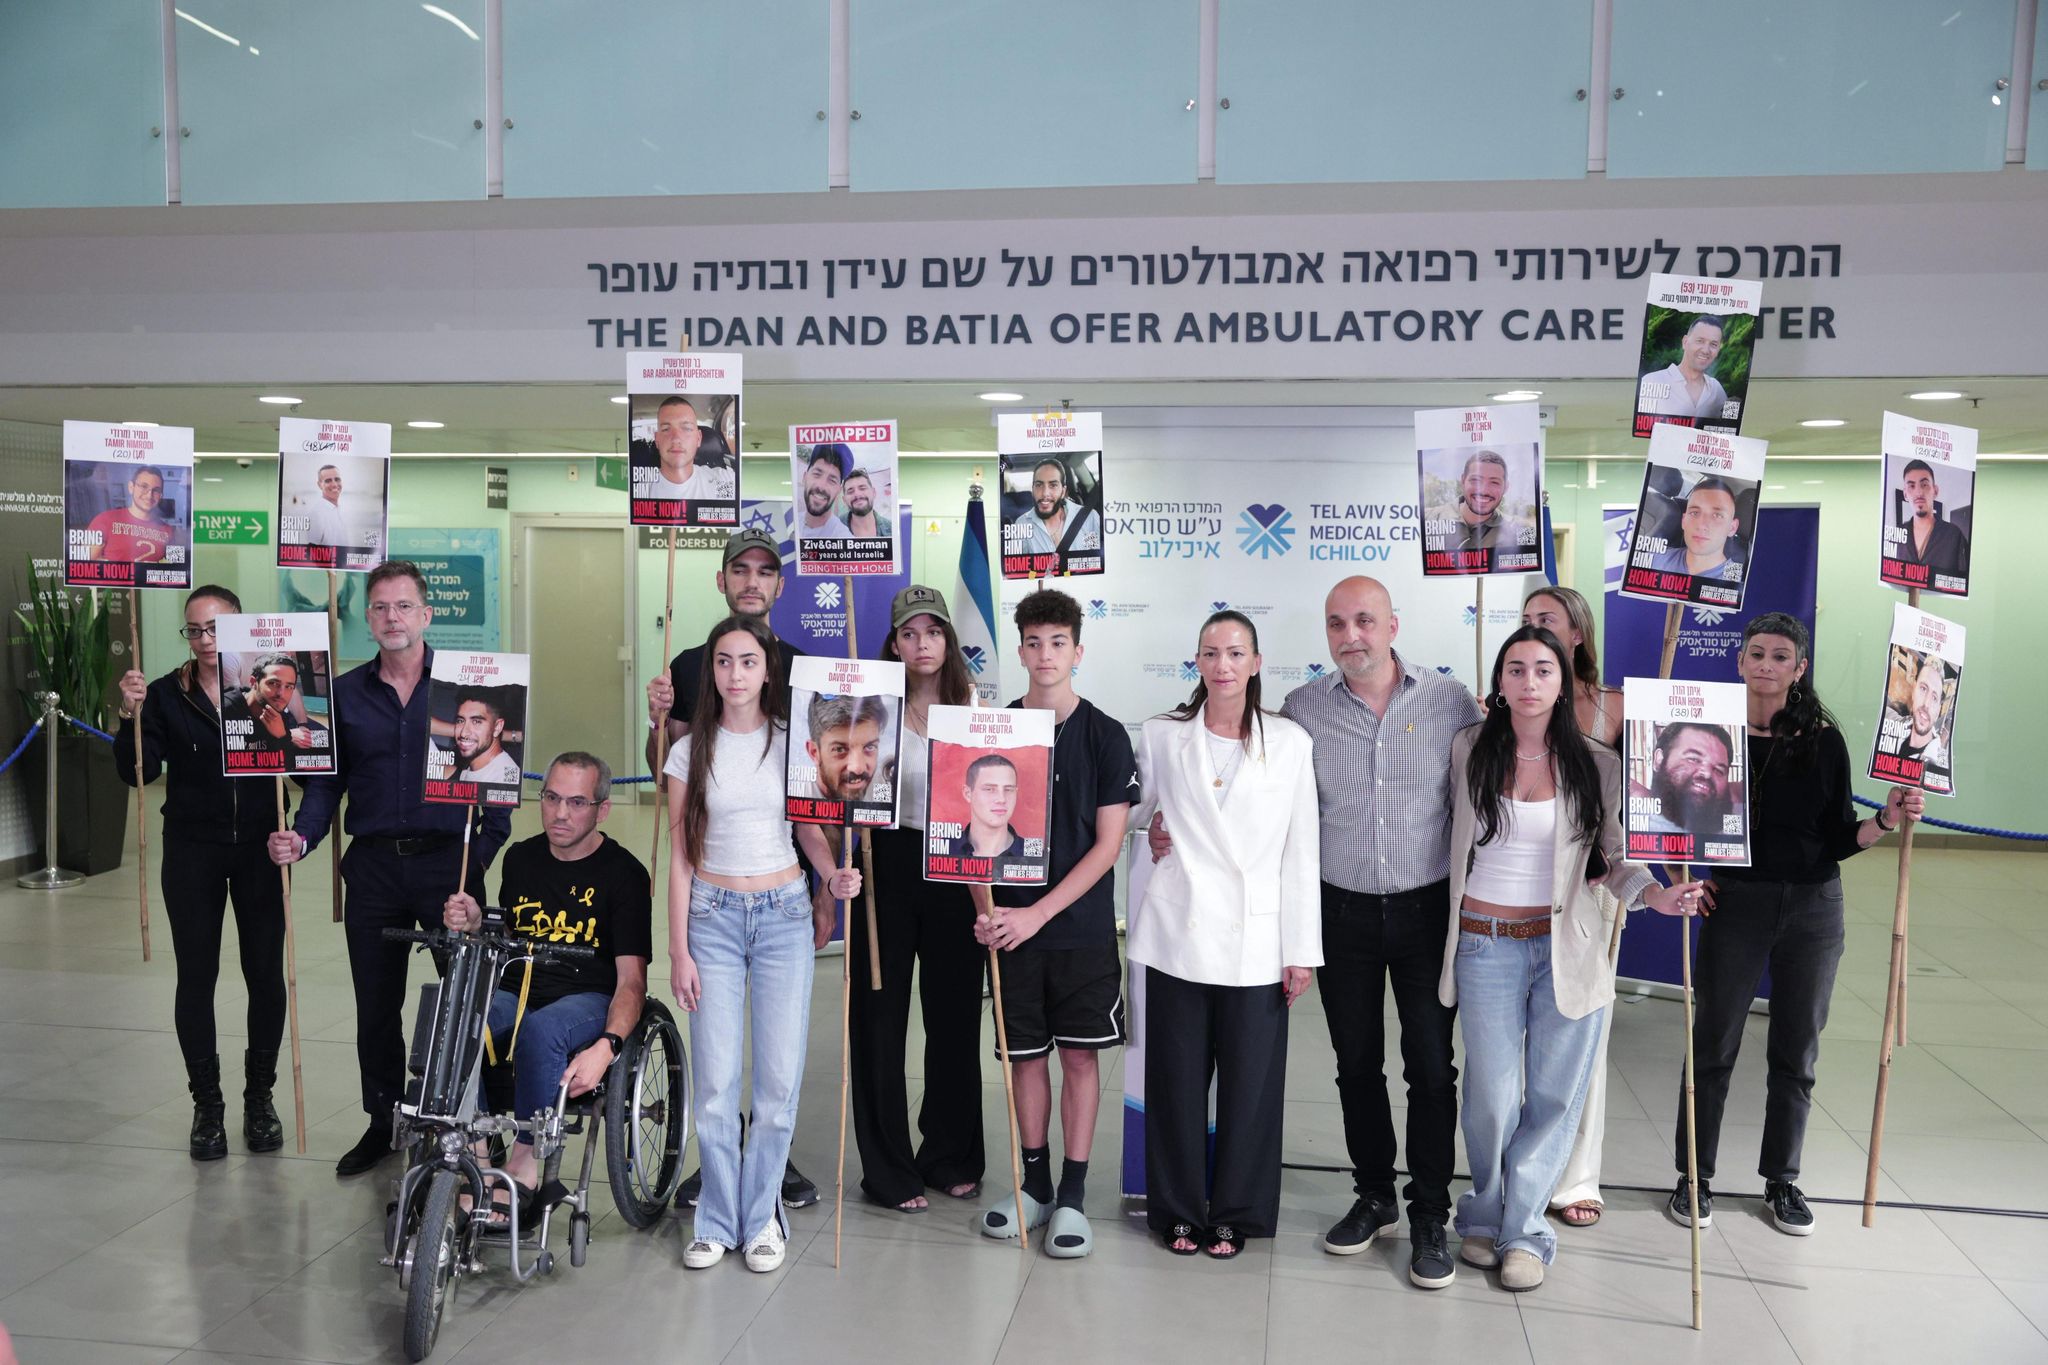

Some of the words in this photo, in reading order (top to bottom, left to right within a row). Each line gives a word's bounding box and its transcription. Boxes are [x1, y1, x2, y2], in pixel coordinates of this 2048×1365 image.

[1001, 248, 1054, 287] על
[1070, 246, 1325, 286] אמבולטורים
[1342, 250, 1478, 283] רפואה
[1494, 239, 1681, 281] לשירותי
[1696, 244, 1842, 279] המרכז
[587, 262, 678, 293] עופר
[693, 260, 808, 291] ובתיה
[822, 258, 907, 298] עידן
[922, 257, 986, 288] שם
[1680, 281, 1696, 294] (53)
[587, 318, 667, 347] THE
[684, 317, 783, 346] IDAN
[797, 316, 887, 346] AND
[907, 314, 1033, 344] BATIA
[1050, 313, 1162, 343] OFER
[1175, 310, 1484, 342] AMBULATORY
[1501, 309, 1624, 341] CARE
[643, 369, 655, 378] BAR
[655, 369, 682, 378] ABRAHAM
[683, 369, 725, 379] KUPERSHTEIN
[674, 379, 688, 389] (22)
[1640, 382, 1671, 400] BRING
[799, 426, 889, 443] KIDNAPPED
[1462, 423, 1475, 432] ITAY
[105, 438, 125, 448] TAMIR
[126, 440, 154, 450] NIMRODI
[1687, 443, 1710, 456] MATAN
[633, 466, 660, 483] BRING
[633, 481, 650, 499] HIM
[633, 499, 657, 517] HOME
[659, 499, 688, 518] NOW!
[1135, 502, 1180, 514] הרפואי
[1182, 502, 1222, 514] המרכז
[1310, 504, 1342, 519] TEL
[1345, 504, 1386, 520] AVIV
[199, 515, 242, 530] יציאה
[281, 515, 311, 532] BRING
[1104, 518, 1171, 535] סוראס
[1425, 519, 1457, 535] BRING
[69, 529, 103, 546] BRING
[208, 530, 235, 540] EXIT
[280, 529, 299, 545] HIM
[1004, 523, 1033, 540] BRING
[1310, 525, 1387, 541] MEDICAL
[1389, 526, 1420, 541] CEN
[1883, 526, 1908, 544] BRING
[804, 539, 844, 550] Ziv&Gali
[846, 538, 889, 550] Berman
[1004, 540, 1024, 555] HIM
[1138, 537, 1221, 559] איכילוב
[1426, 534, 1446, 551] HIM
[1636, 534, 1669, 554] BRING
[1882, 541, 1898, 559] HIM
[69, 544, 91, 561] HIM
[279, 545, 307, 561] HOME
[309, 545, 337, 564] NOW!
[819, 552, 838, 561] years
[839, 551, 851, 560] old
[853, 550, 885, 560] Israelis
[1310, 544, 1391, 561] ICHILOV
[1426, 551, 1455, 569] HOME
[1457, 549, 1488, 567] NOW!
[1631, 551, 1655, 569] HIM
[69, 561, 100, 578] HOME
[103, 562, 135, 581] NOW!
[801, 563, 831, 574] BRING
[831, 563, 860, 574] THEM
[861, 561, 894, 574] HOME
[1004, 556, 1032, 573] HOME
[1882, 558, 1905, 578] HOME
[1905, 562, 1929, 583] NOW!
[429, 575, 461, 585] המרכז
[1628, 566, 1659, 588] HOME
[1660, 572, 1693, 594] NOW!
[435, 588, 470, 601] לטיפול
[452, 604, 467, 618] על
[250, 629, 272, 638] NIMROD
[272, 628, 292, 637] COHEN
[812, 628, 844, 638] איכילוב
[1689, 646, 1728, 657] איכילוב
[483, 666, 500, 675] DAVID
[828, 671, 846, 682] DAVID
[839, 683, 852, 694] (33)
[1668, 695, 1687, 706] EITAN
[1687, 697, 1705, 707] HORN
[1670, 707, 1690, 719] (38)
[225, 719, 255, 736] BRING
[969, 723, 988, 733] OMER
[988, 725, 1013, 735] NEUTRA
[1881, 718, 1911, 739] BRING
[226, 734, 246, 751] HIM
[984, 735, 997, 746] (22)
[227, 751, 256, 768] HOME
[256, 749, 286, 767] NOW!
[428, 750, 455, 767] BRING
[1875, 753, 1901, 775] HOME
[427, 765, 445, 780] HIM
[788, 765, 817, 782] BRING
[425, 780, 451, 796] HOME
[453, 782, 479, 799] NOW!
[787, 798, 814, 817] HOME
[815, 800, 845, 819] NOW!
[1629, 797, 1662, 815] BRING
[930, 821, 963, 839] BRING
[1629, 814, 1650, 832] HIM
[930, 838, 951, 855] HIM
[1629, 833, 1659, 851] HOME
[1661, 833, 1694, 853] NOW!
[929, 855, 959, 873] HOME
[961, 857, 993, 876] NOW!
